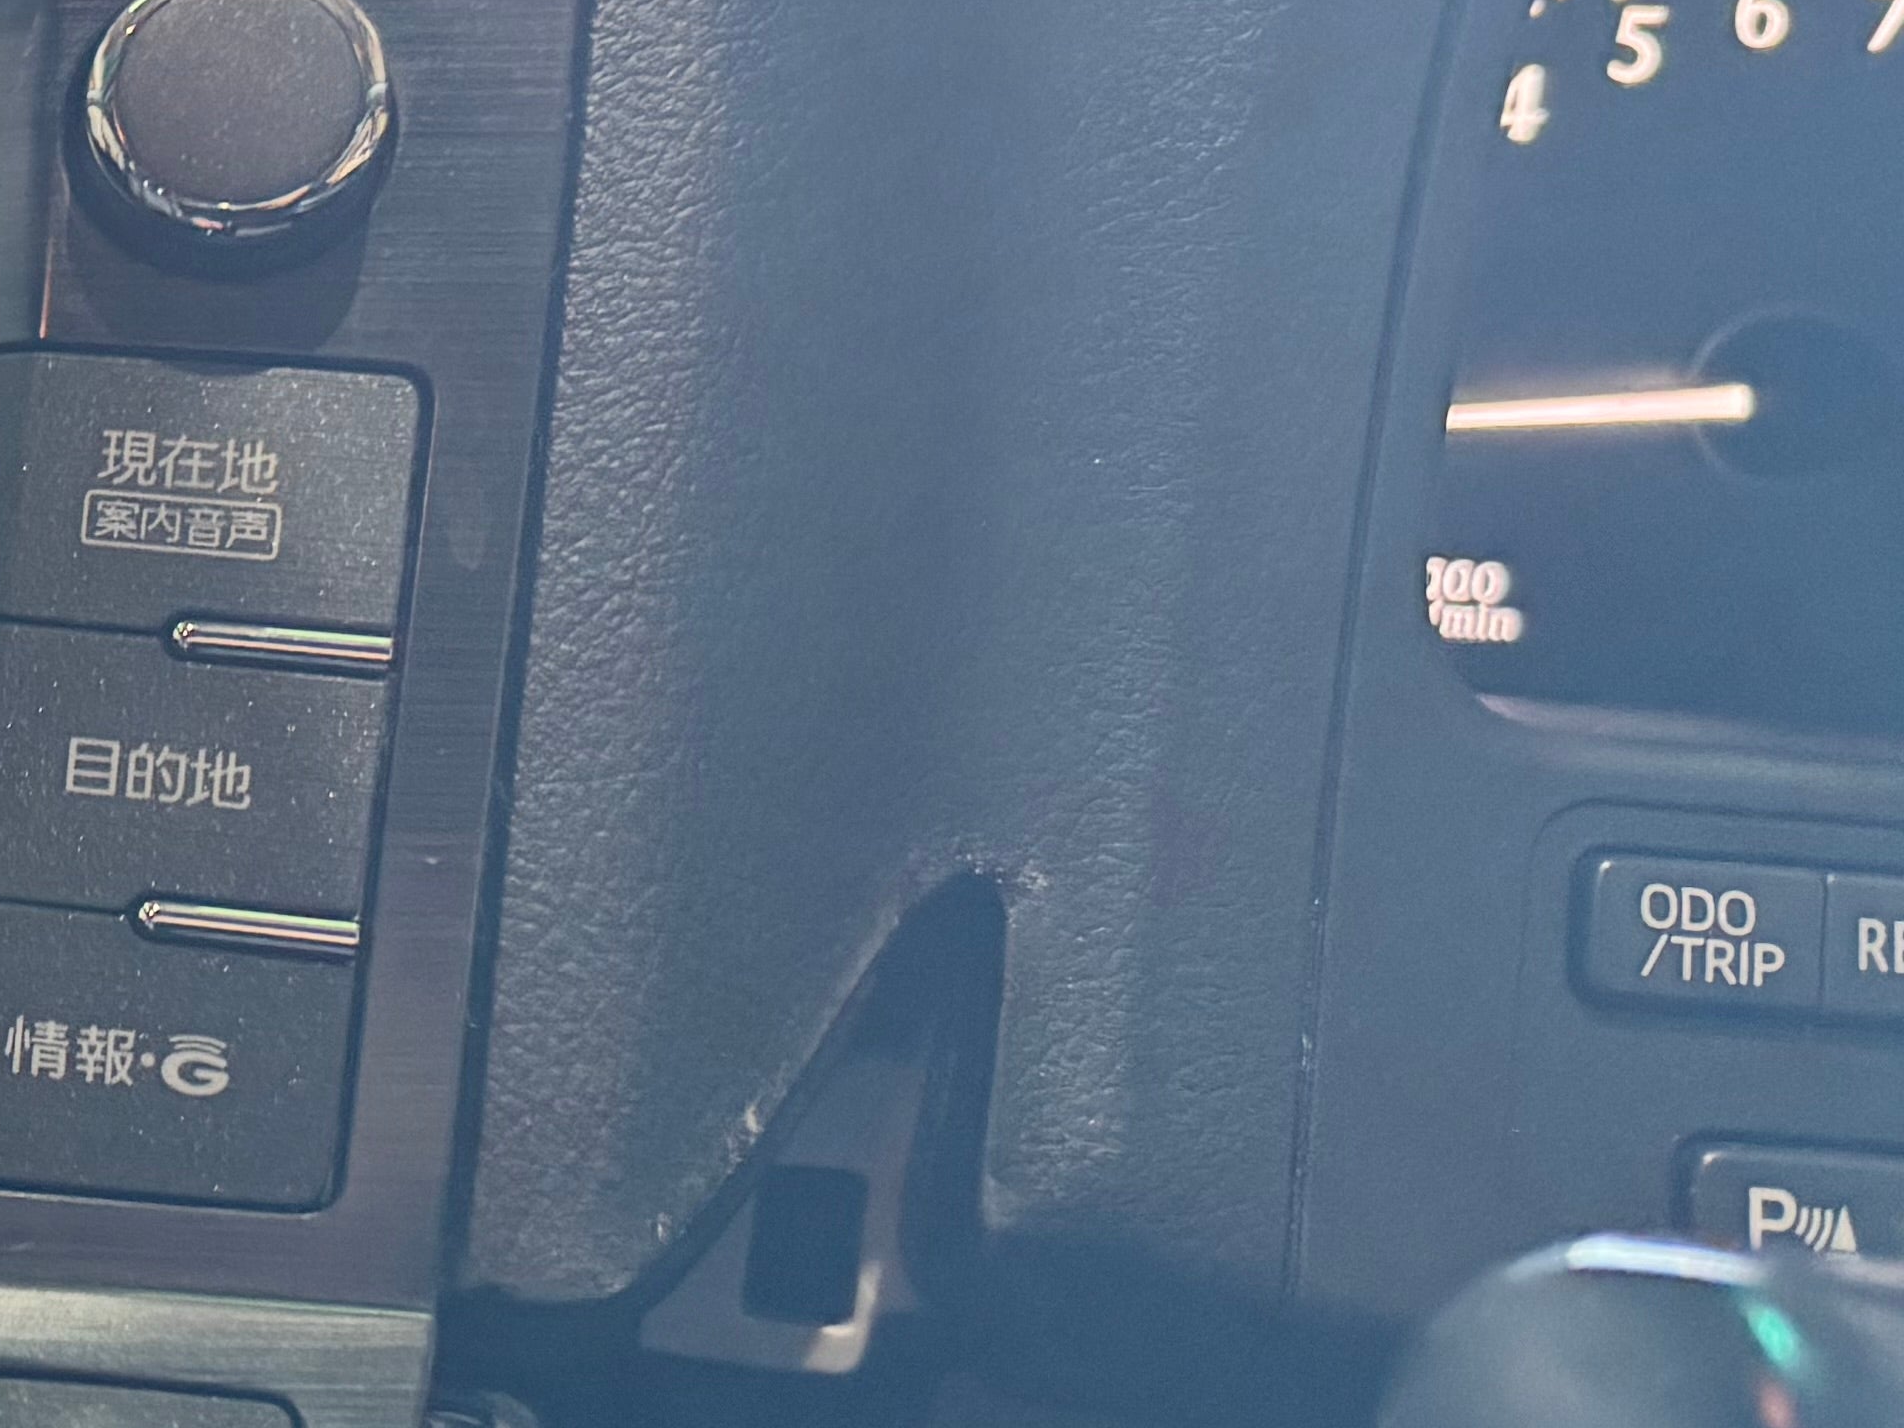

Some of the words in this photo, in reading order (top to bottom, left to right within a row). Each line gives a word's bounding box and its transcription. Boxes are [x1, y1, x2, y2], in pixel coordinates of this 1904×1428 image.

[1606, 4, 1670, 85] 5
[96, 429, 279, 495] 現在地
[94, 499, 272, 550] 案内音声
[65, 737, 252, 810] 目的地
[1639, 883, 1756, 935] ODO
[1640, 933, 1786, 987] /TRIP
